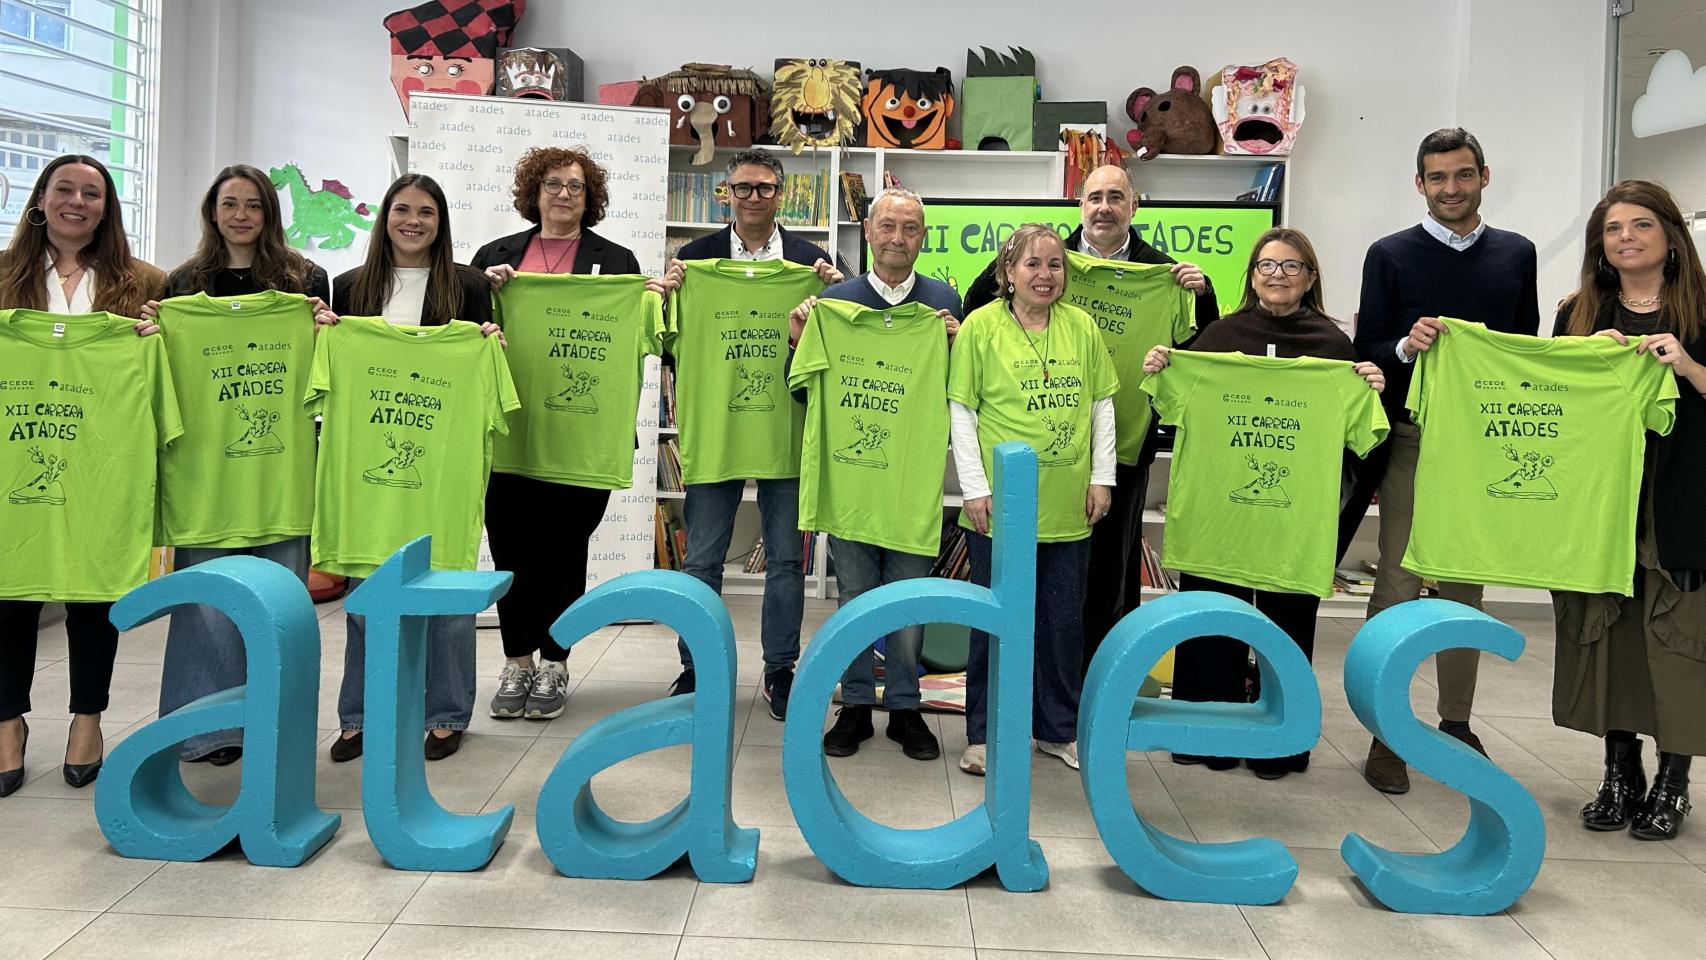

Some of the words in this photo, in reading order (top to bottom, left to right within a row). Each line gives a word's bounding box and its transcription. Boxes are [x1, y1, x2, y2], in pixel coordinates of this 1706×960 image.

[411, 101, 448, 111] atades
[469, 104, 504, 114] atades
[525, 108, 560, 118] atades
[580, 112, 615, 122] atades
[635, 116, 669, 126] atades
[440, 122, 475, 132] atades
[496, 126, 532, 136] atades
[552, 130, 587, 140] atades
[608, 133, 642, 143] atades
[411, 140, 446, 150] atades
[468, 143, 503, 153] atades
[634, 154, 667, 164] atades
[438, 161, 474, 171] atades
[495, 165, 512, 174] ata
[466, 182, 502, 192] atades
[632, 192, 666, 202] atades
[448, 200, 472, 210] ades
[632, 229, 664, 240] atades
[919, 225, 949, 253] II
[452, 239, 470, 248] des
[641, 268, 663, 277] ades
[1071, 294, 1088, 306] XII
[1091, 299, 1132, 319] CARRERA
[590, 313, 619, 322] atades
[758, 310, 786, 319] atades
[548, 328, 565, 338] XII
[570, 328, 611, 343] CARRERA
[721, 330, 737, 340] XII
[740, 329, 781, 340] CARRERA
[258, 342, 292, 350] atades
[548, 343, 607, 362] ATADES
[725, 344, 777, 360] ATADES
[211, 368, 233, 379] XII
[237, 361, 287, 376] CARRERA
[885, 362, 913, 375] atades
[420, 376, 452, 389] atades
[643, 380, 659, 390] des
[840, 375, 858, 387] XII
[862, 378, 905, 395] CARRERA
[1020, 380, 1038, 391] XII
[1043, 377, 1082, 389] CARRERA
[1532, 382, 1568, 392] atades
[59, 383, 94, 394] atades
[219, 379, 284, 401] ATADES
[370, 390, 390, 401] XII
[394, 391, 441, 410] CARRERA
[840, 392, 899, 414] ATADES
[1026, 393, 1080, 411] ATADES
[1274, 398, 1308, 409] atades
[5, 404, 29, 416] XII
[35, 404, 83, 418] CARRERA
[1480, 403, 1502, 414] XII
[1507, 403, 1563, 416] CARRERA
[370, 407, 435, 430] ATADES
[636, 417, 658, 427] ades
[1227, 415, 1247, 427] XII
[1251, 415, 1301, 431] CARRERA
[9, 421, 77, 441] ATADES
[1484, 419, 1559, 438] ATADES
[1230, 431, 1296, 451] ATADES
[634, 454, 656, 465] ades
[621, 493, 656, 503] atades
[602, 511, 628, 522] ades
[620, 532, 654, 541] atades
[592, 550, 626, 560] atades
[95, 441, 1546, 916] atades
